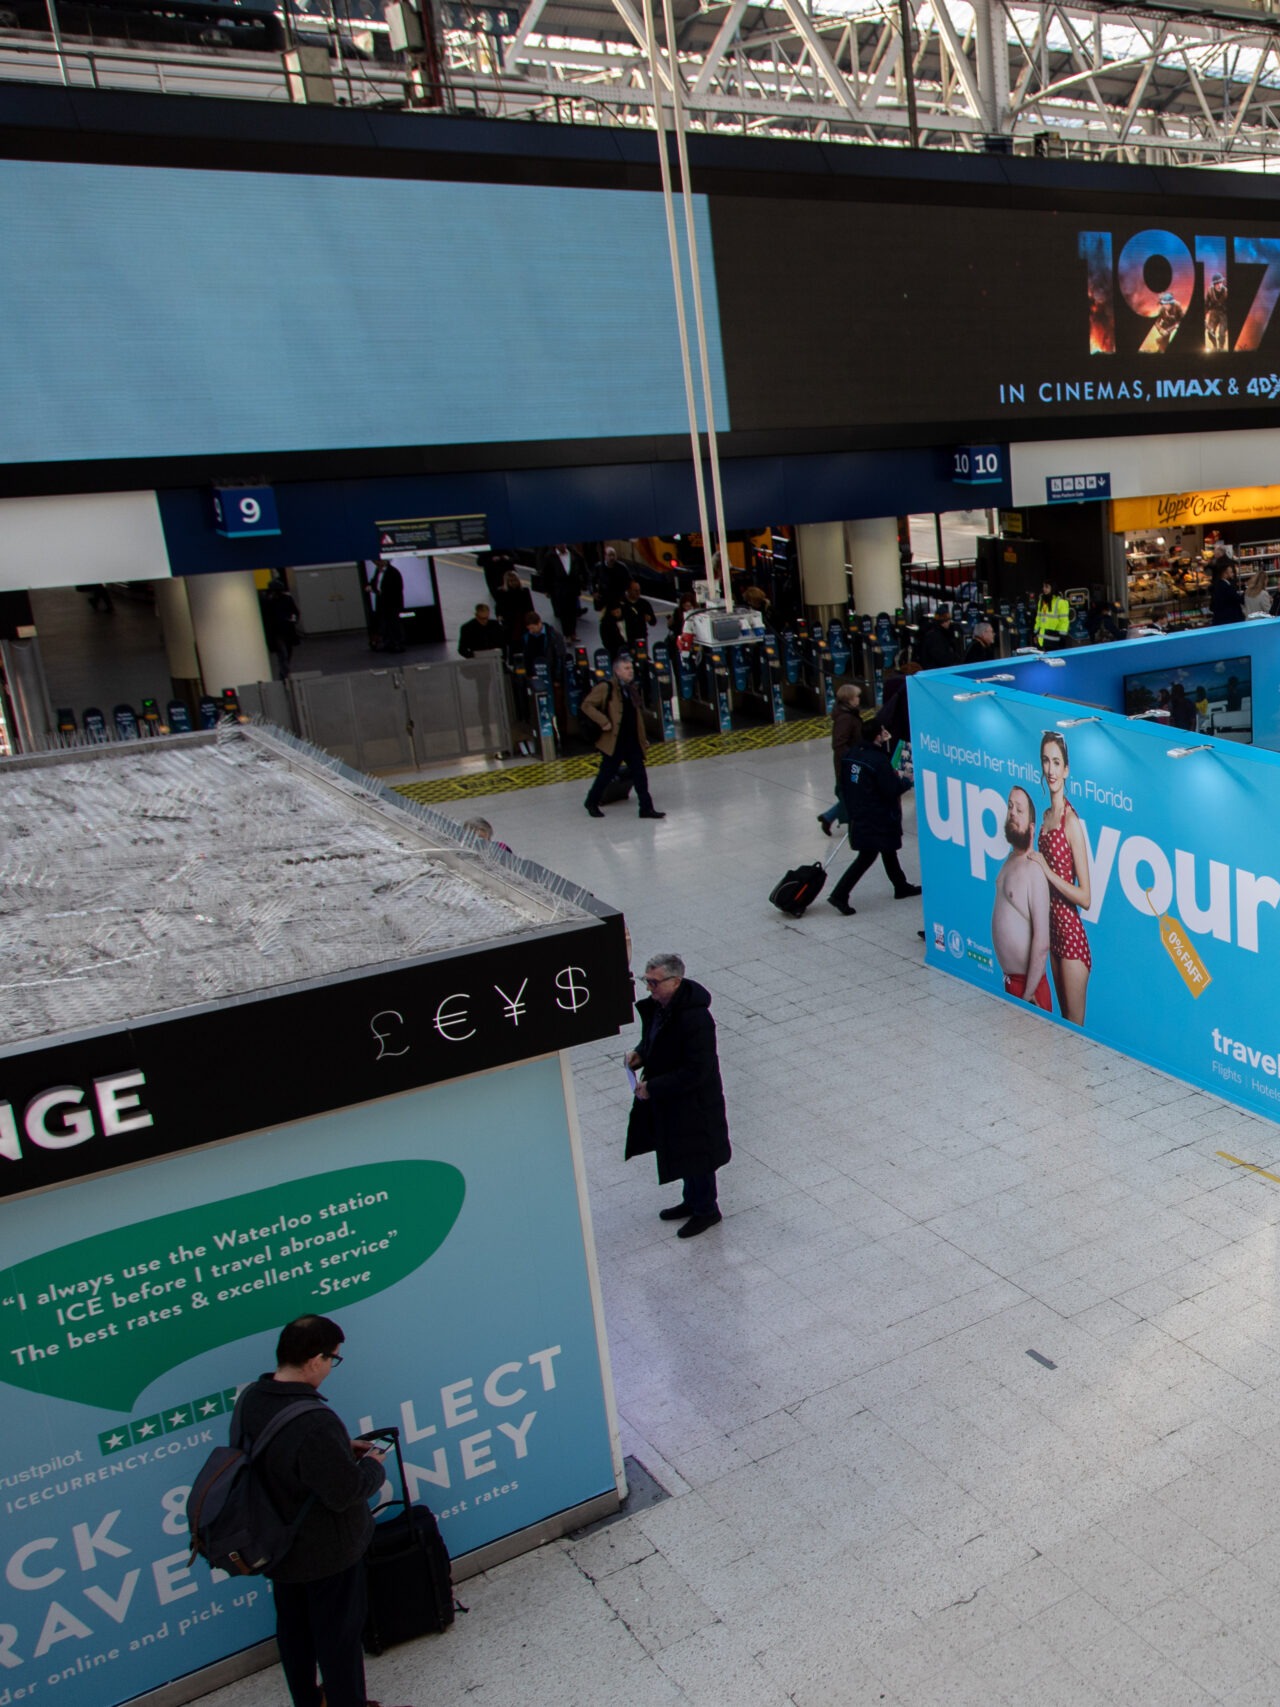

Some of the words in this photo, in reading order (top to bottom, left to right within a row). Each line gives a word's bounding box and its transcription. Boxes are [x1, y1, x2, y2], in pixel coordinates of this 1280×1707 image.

[1000, 384, 1025, 404] IN
[1038, 379, 1152, 403] CINEMAS,
[1156, 378, 1222, 399] IMAX
[1227, 377, 1239, 396] &
[954, 454, 970, 473] 10
[974, 453, 998, 474] 10
[240, 497, 261, 523] 9
[1157, 494, 1198, 524] Upper
[1192, 492, 1231, 517] Crust
[919, 731, 941, 755] Mel
[943, 743, 982, 767] upped
[983, 751, 1004, 772] her
[1007, 759, 1041, 785] thrills
[1071, 776, 1082, 796] in
[1085, 780, 1133, 812] Florida
[922, 768, 1012, 882] up
[370, 1010, 410, 1060] £
[432, 993, 476, 1041] €
[494, 977, 528, 1026] ¥
[555, 965, 590, 1013] $
[1212, 1060, 1242, 1084] Flights
[37, 1272, 115, 1305] always
[122, 1259, 162, 1279] use
[168, 1245, 207, 1265] the
[212, 1213, 312, 1251] Waterloo
[319, 1190, 389, 1219] station
[56, 1297, 105, 1326] ICE
[112, 1278, 187, 1309] before
[194, 1267, 203, 1283] I
[211, 1245, 272, 1278] travel
[280, 1221, 357, 1257] abroad.
[311, 1270, 372, 1296] -Steve
[11, 1344, 60, 1366] The
[67, 1322, 120, 1349] best
[127, 1303, 183, 1331] rates
[191, 1291, 210, 1310] &
[217, 1260, 314, 1302] excellent
[6, 1429, 214, 1515] ICECURRENCY.CO.UK
[5, 1509, 133, 1591] CK
[47, 1648, 120, 1686] online
[129, 1622, 169, 1653] and
[178, 1602, 225, 1636] pick
[232, 1589, 260, 1608] up
[475, 1479, 520, 1505] rates
